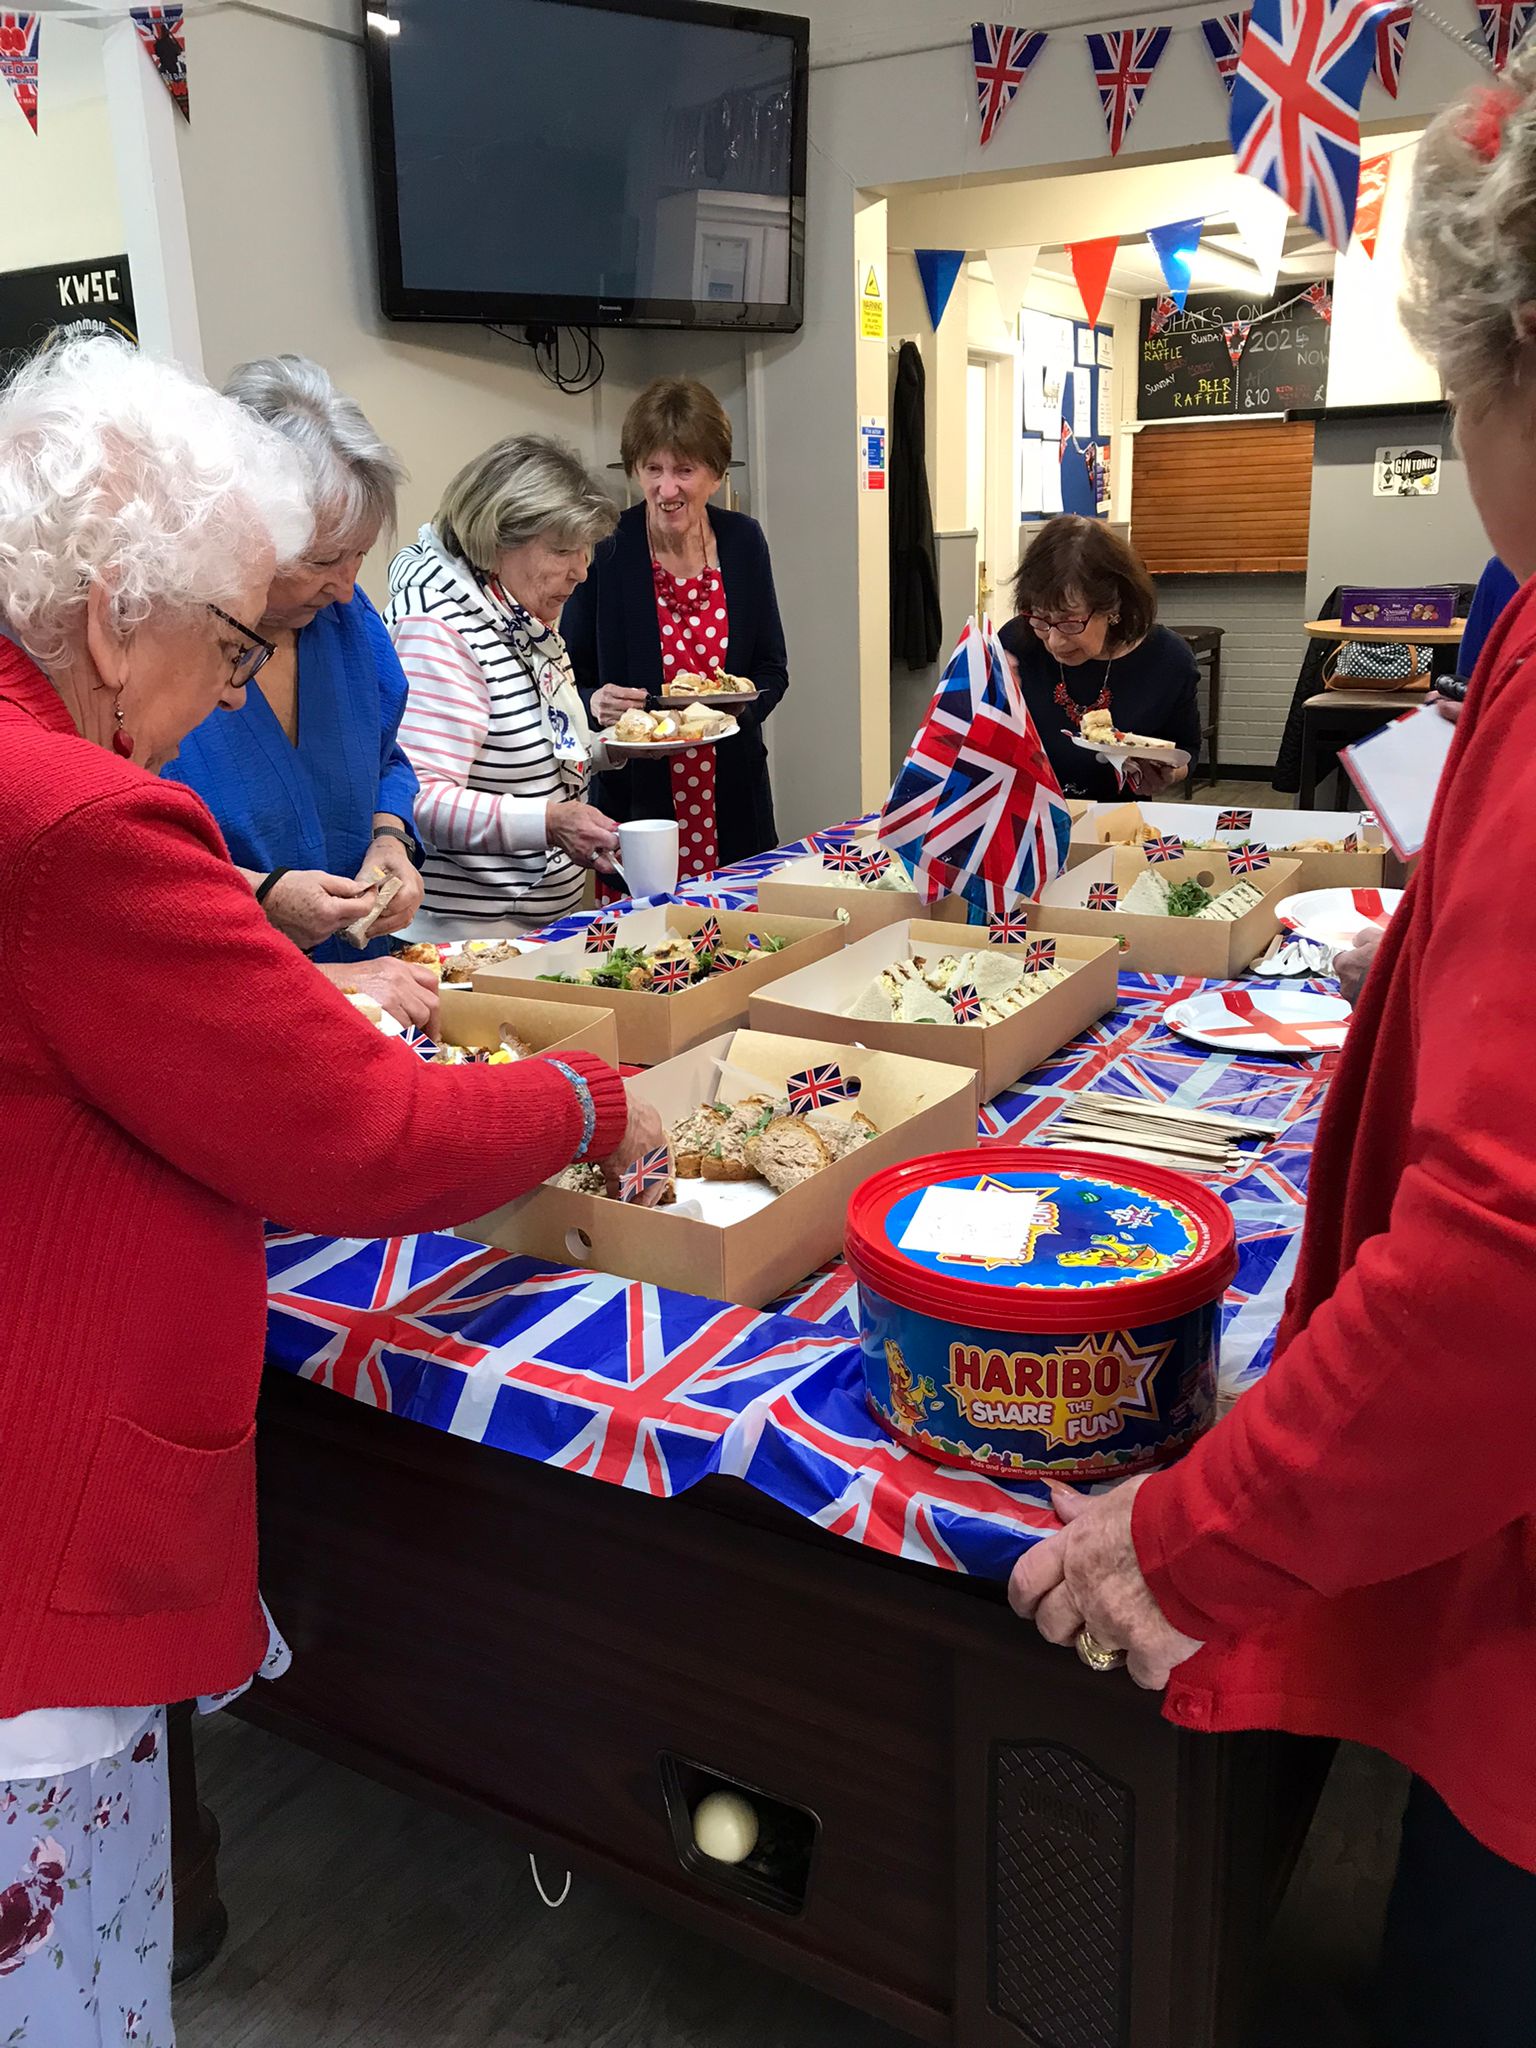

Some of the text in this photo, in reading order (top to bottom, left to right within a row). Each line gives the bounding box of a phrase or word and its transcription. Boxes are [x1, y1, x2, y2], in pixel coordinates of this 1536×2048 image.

[15, 65, 35, 74] DAY
[58, 269, 119, 306] KWSC
[1236, 304, 1263, 323] ON
[1144, 338, 1169, 351] MEAT
[1190, 333, 1224, 345] SUNDAY
[1144, 345, 1183, 361] RAFFLE
[1145, 373, 1176, 396] SUNDAY
[1198, 377, 1232, 393] BEER
[1173, 391, 1232, 408] RAFFLE
[1395, 458, 1412, 474] GIN
[1411, 456, 1436, 472] TONIC
[955, 1347, 1122, 1399] HARIBO
[971, 1400, 1093, 1425] SHARE THE
[1066, 1409, 1119, 1440] FUN
[970, 1460, 984, 1468] Kids
[985, 1463, 999, 1471] and
[1001, 1465, 1038, 1476] grown-ups
[1039, 1468, 1054, 1476] love
